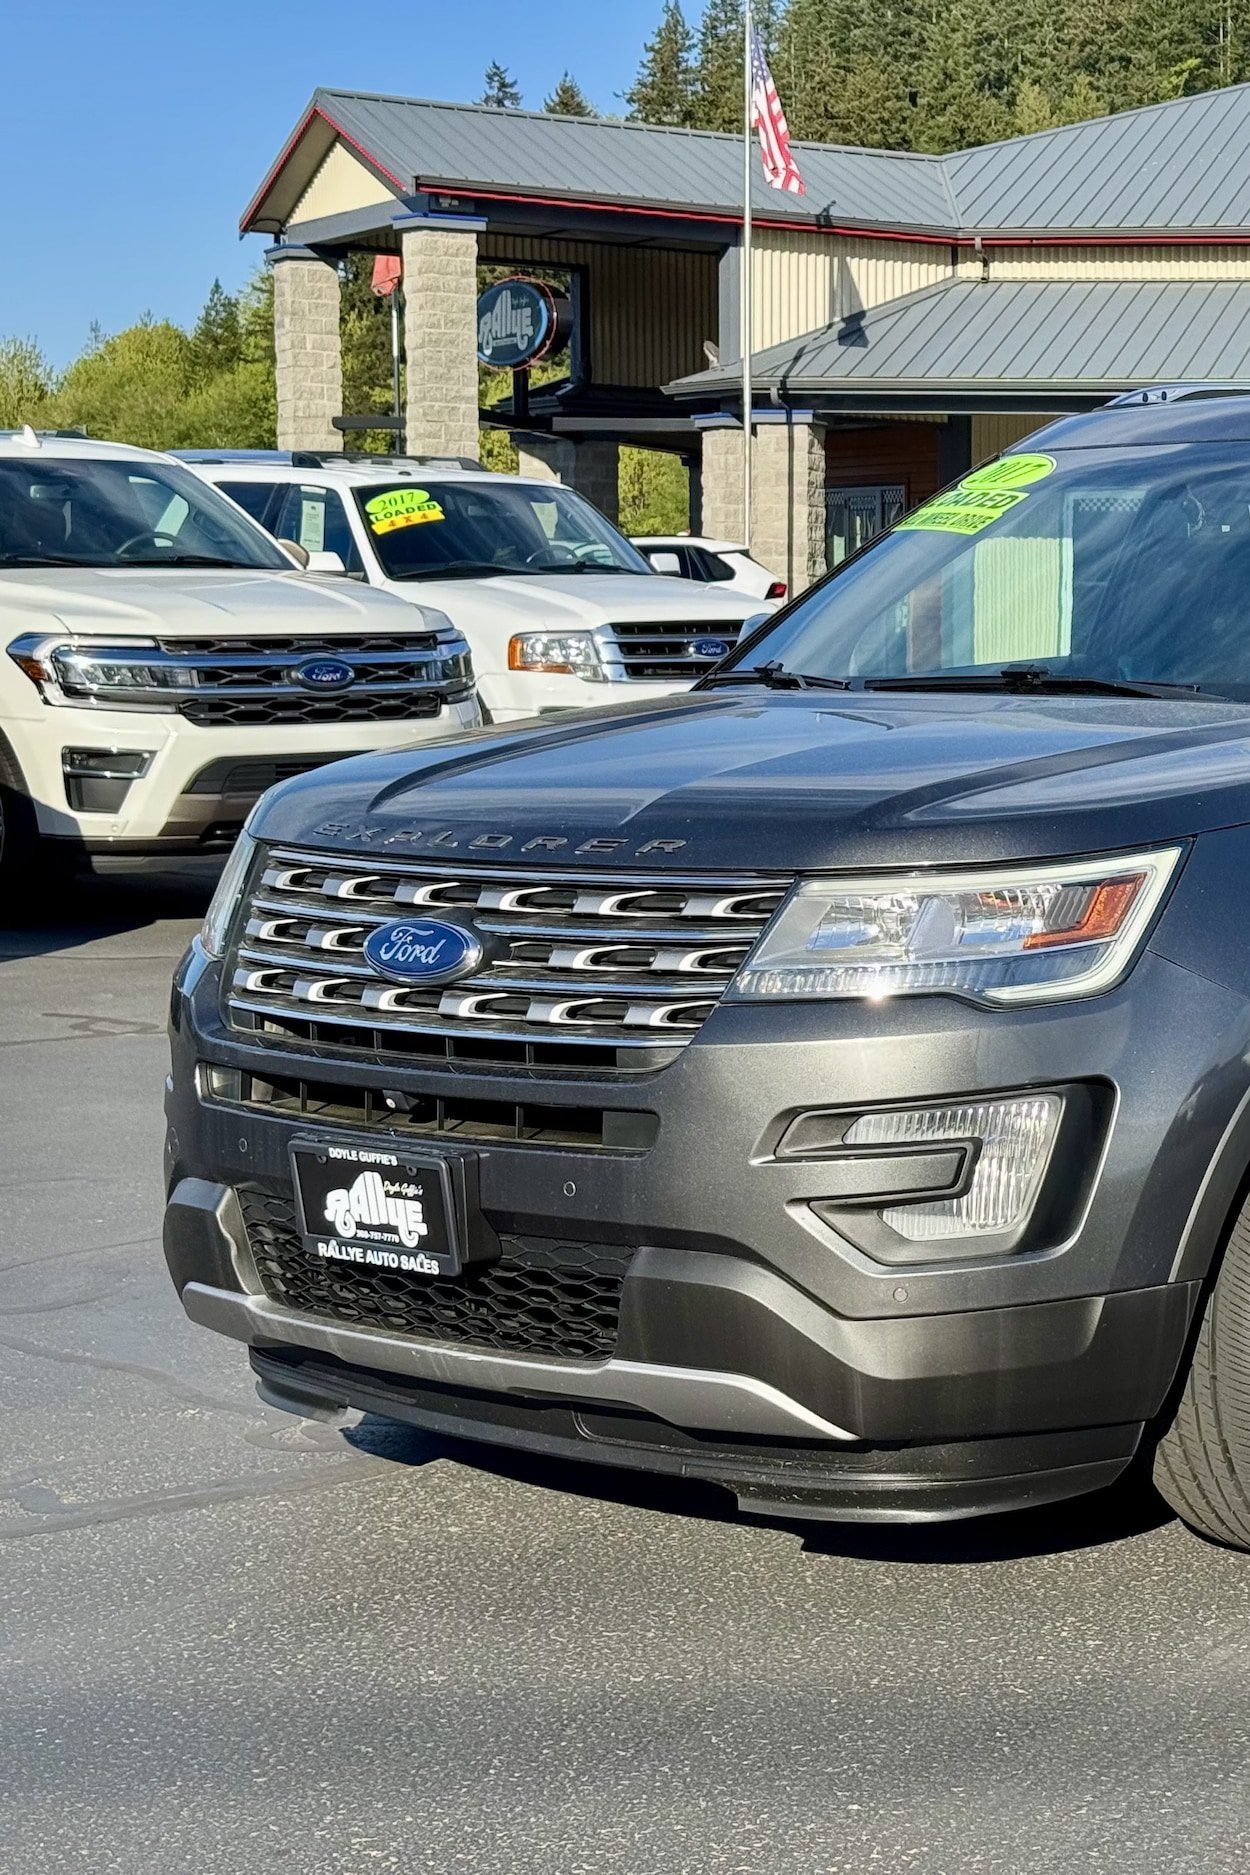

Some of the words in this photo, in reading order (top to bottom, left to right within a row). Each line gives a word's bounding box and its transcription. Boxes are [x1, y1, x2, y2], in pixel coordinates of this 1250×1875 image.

[378, 491, 415, 512] 2017
[374, 503, 437, 523] LOADED
[701, 643, 723, 655] Ford
[311, 665, 343, 682] Ford
[312, 821, 689, 857] EXPLORER
[379, 925, 447, 966] Ford
[328, 1147, 358, 1161] DOYLE
[358, 1151, 398, 1166] GUFFIE'S
[317, 1240, 365, 1263] RALLYE
[366, 1249, 399, 1267] AUTO
[400, 1253, 440, 1275] SALES
